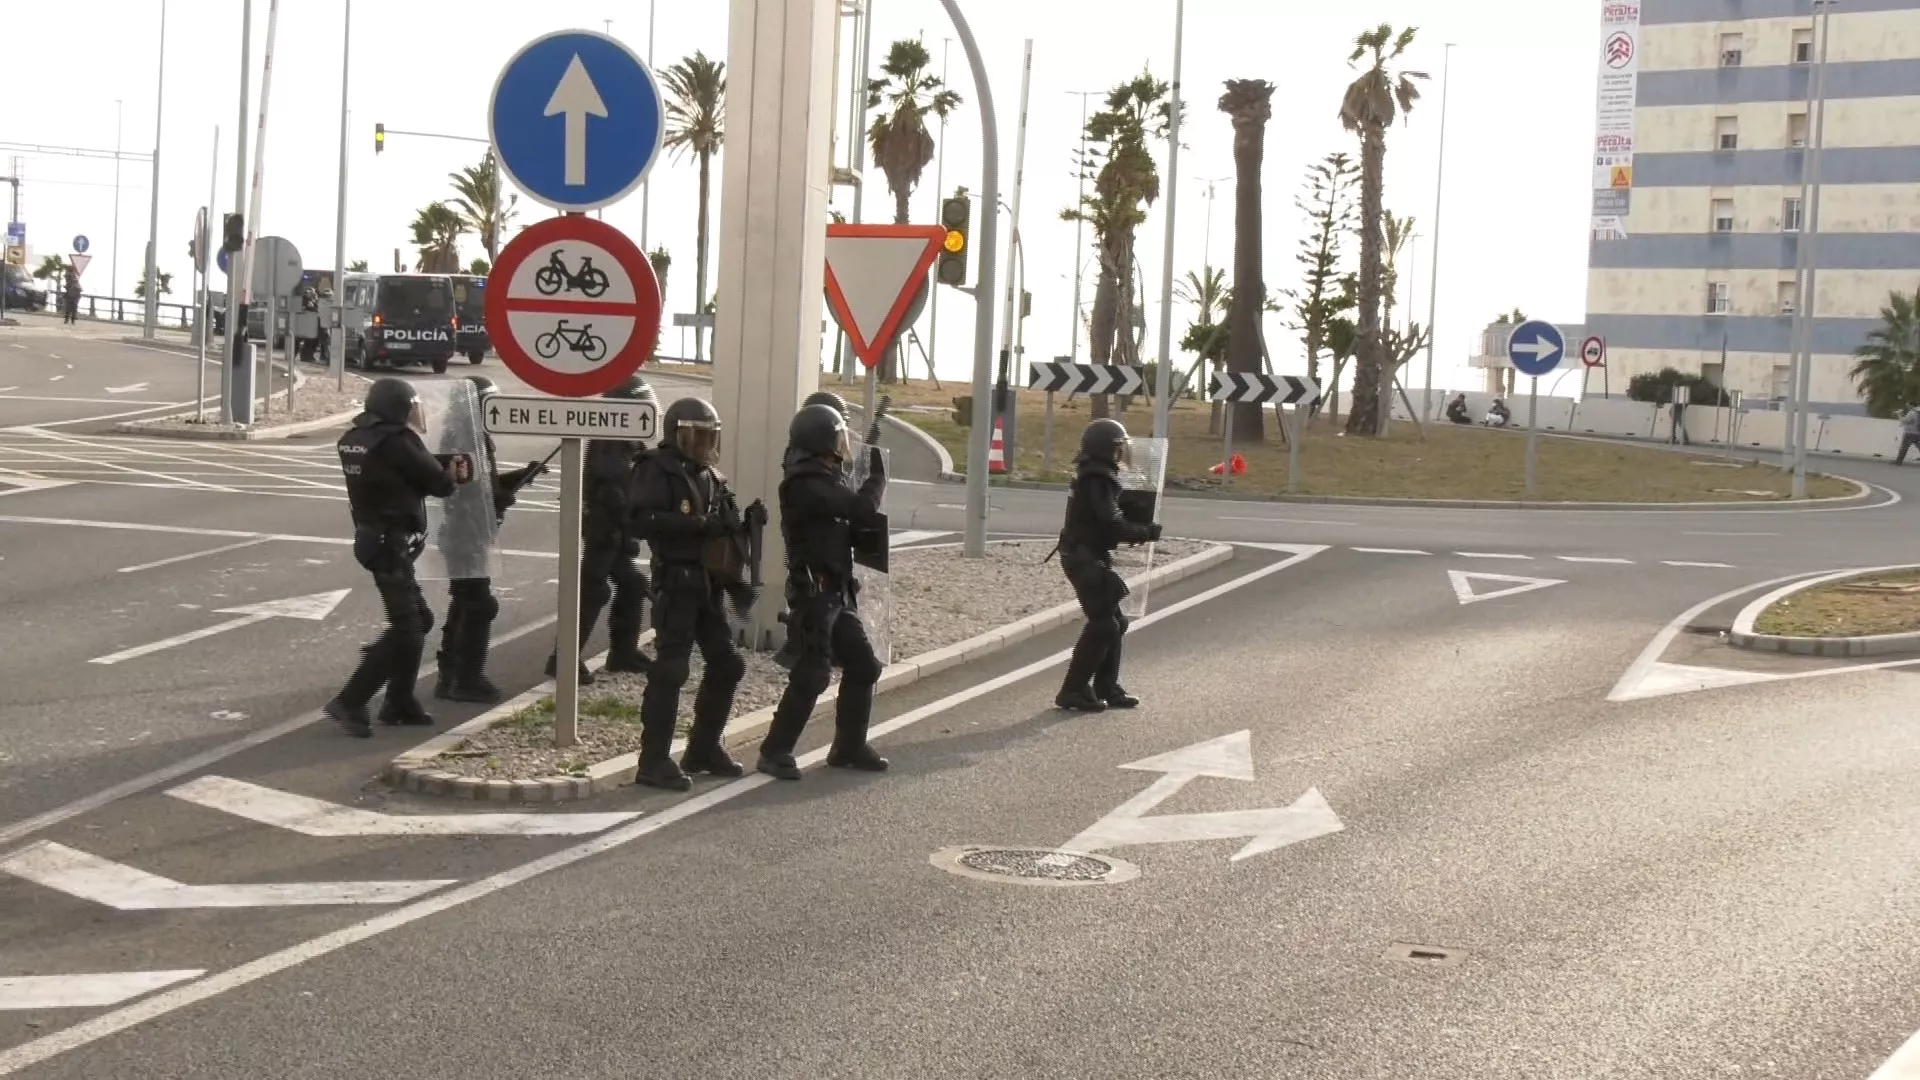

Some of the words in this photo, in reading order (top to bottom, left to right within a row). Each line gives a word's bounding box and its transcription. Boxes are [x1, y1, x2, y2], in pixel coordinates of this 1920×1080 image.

[383, 328, 448, 341] POLICÍA
[510, 408, 530, 424] EN
[539, 409, 558, 425] EL
[567, 410, 629, 428] PUENTE
